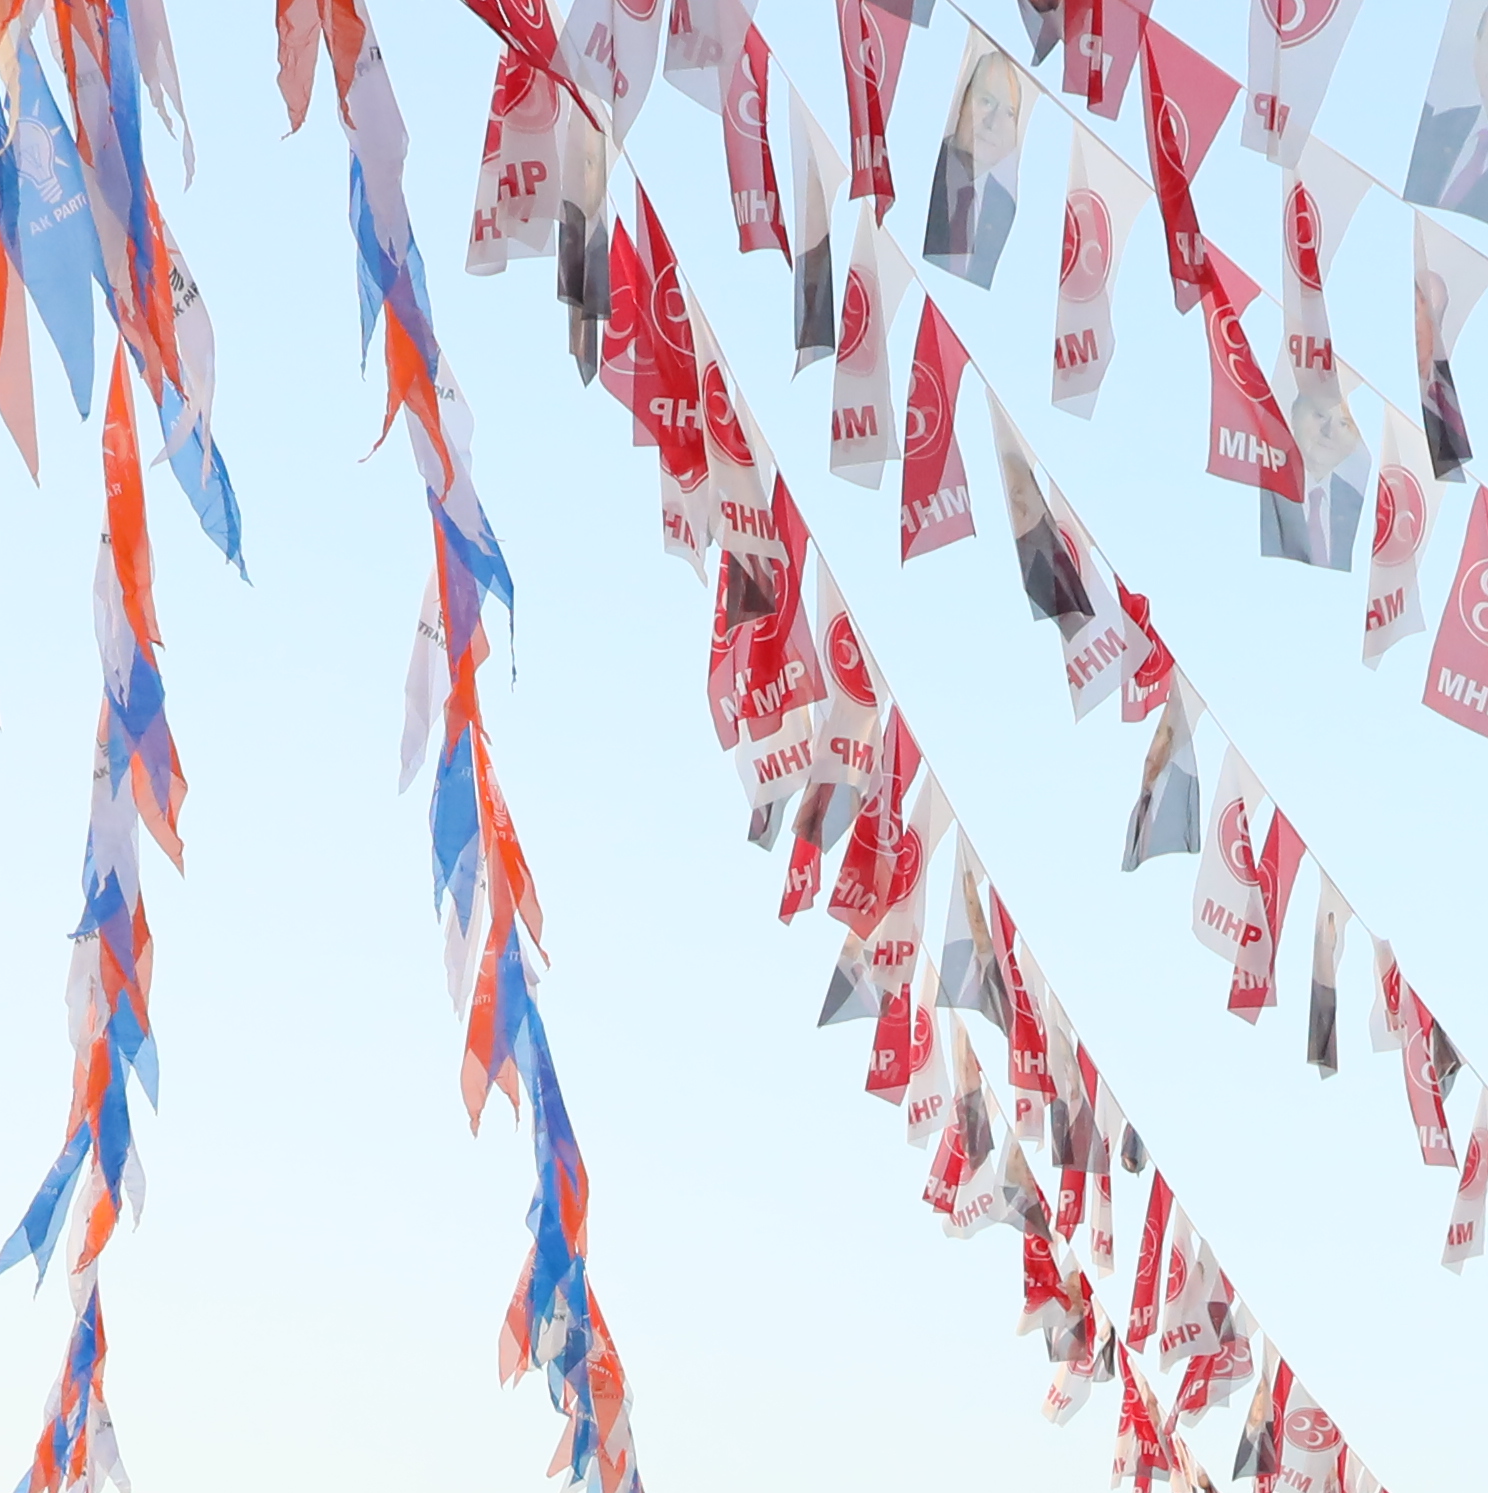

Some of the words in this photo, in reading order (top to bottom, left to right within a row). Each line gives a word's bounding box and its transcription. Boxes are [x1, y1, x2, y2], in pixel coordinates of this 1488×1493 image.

[28, 216, 54, 237] AK
[1218, 427, 1287, 473] MHP
[1200, 898, 1263, 950] MHP
